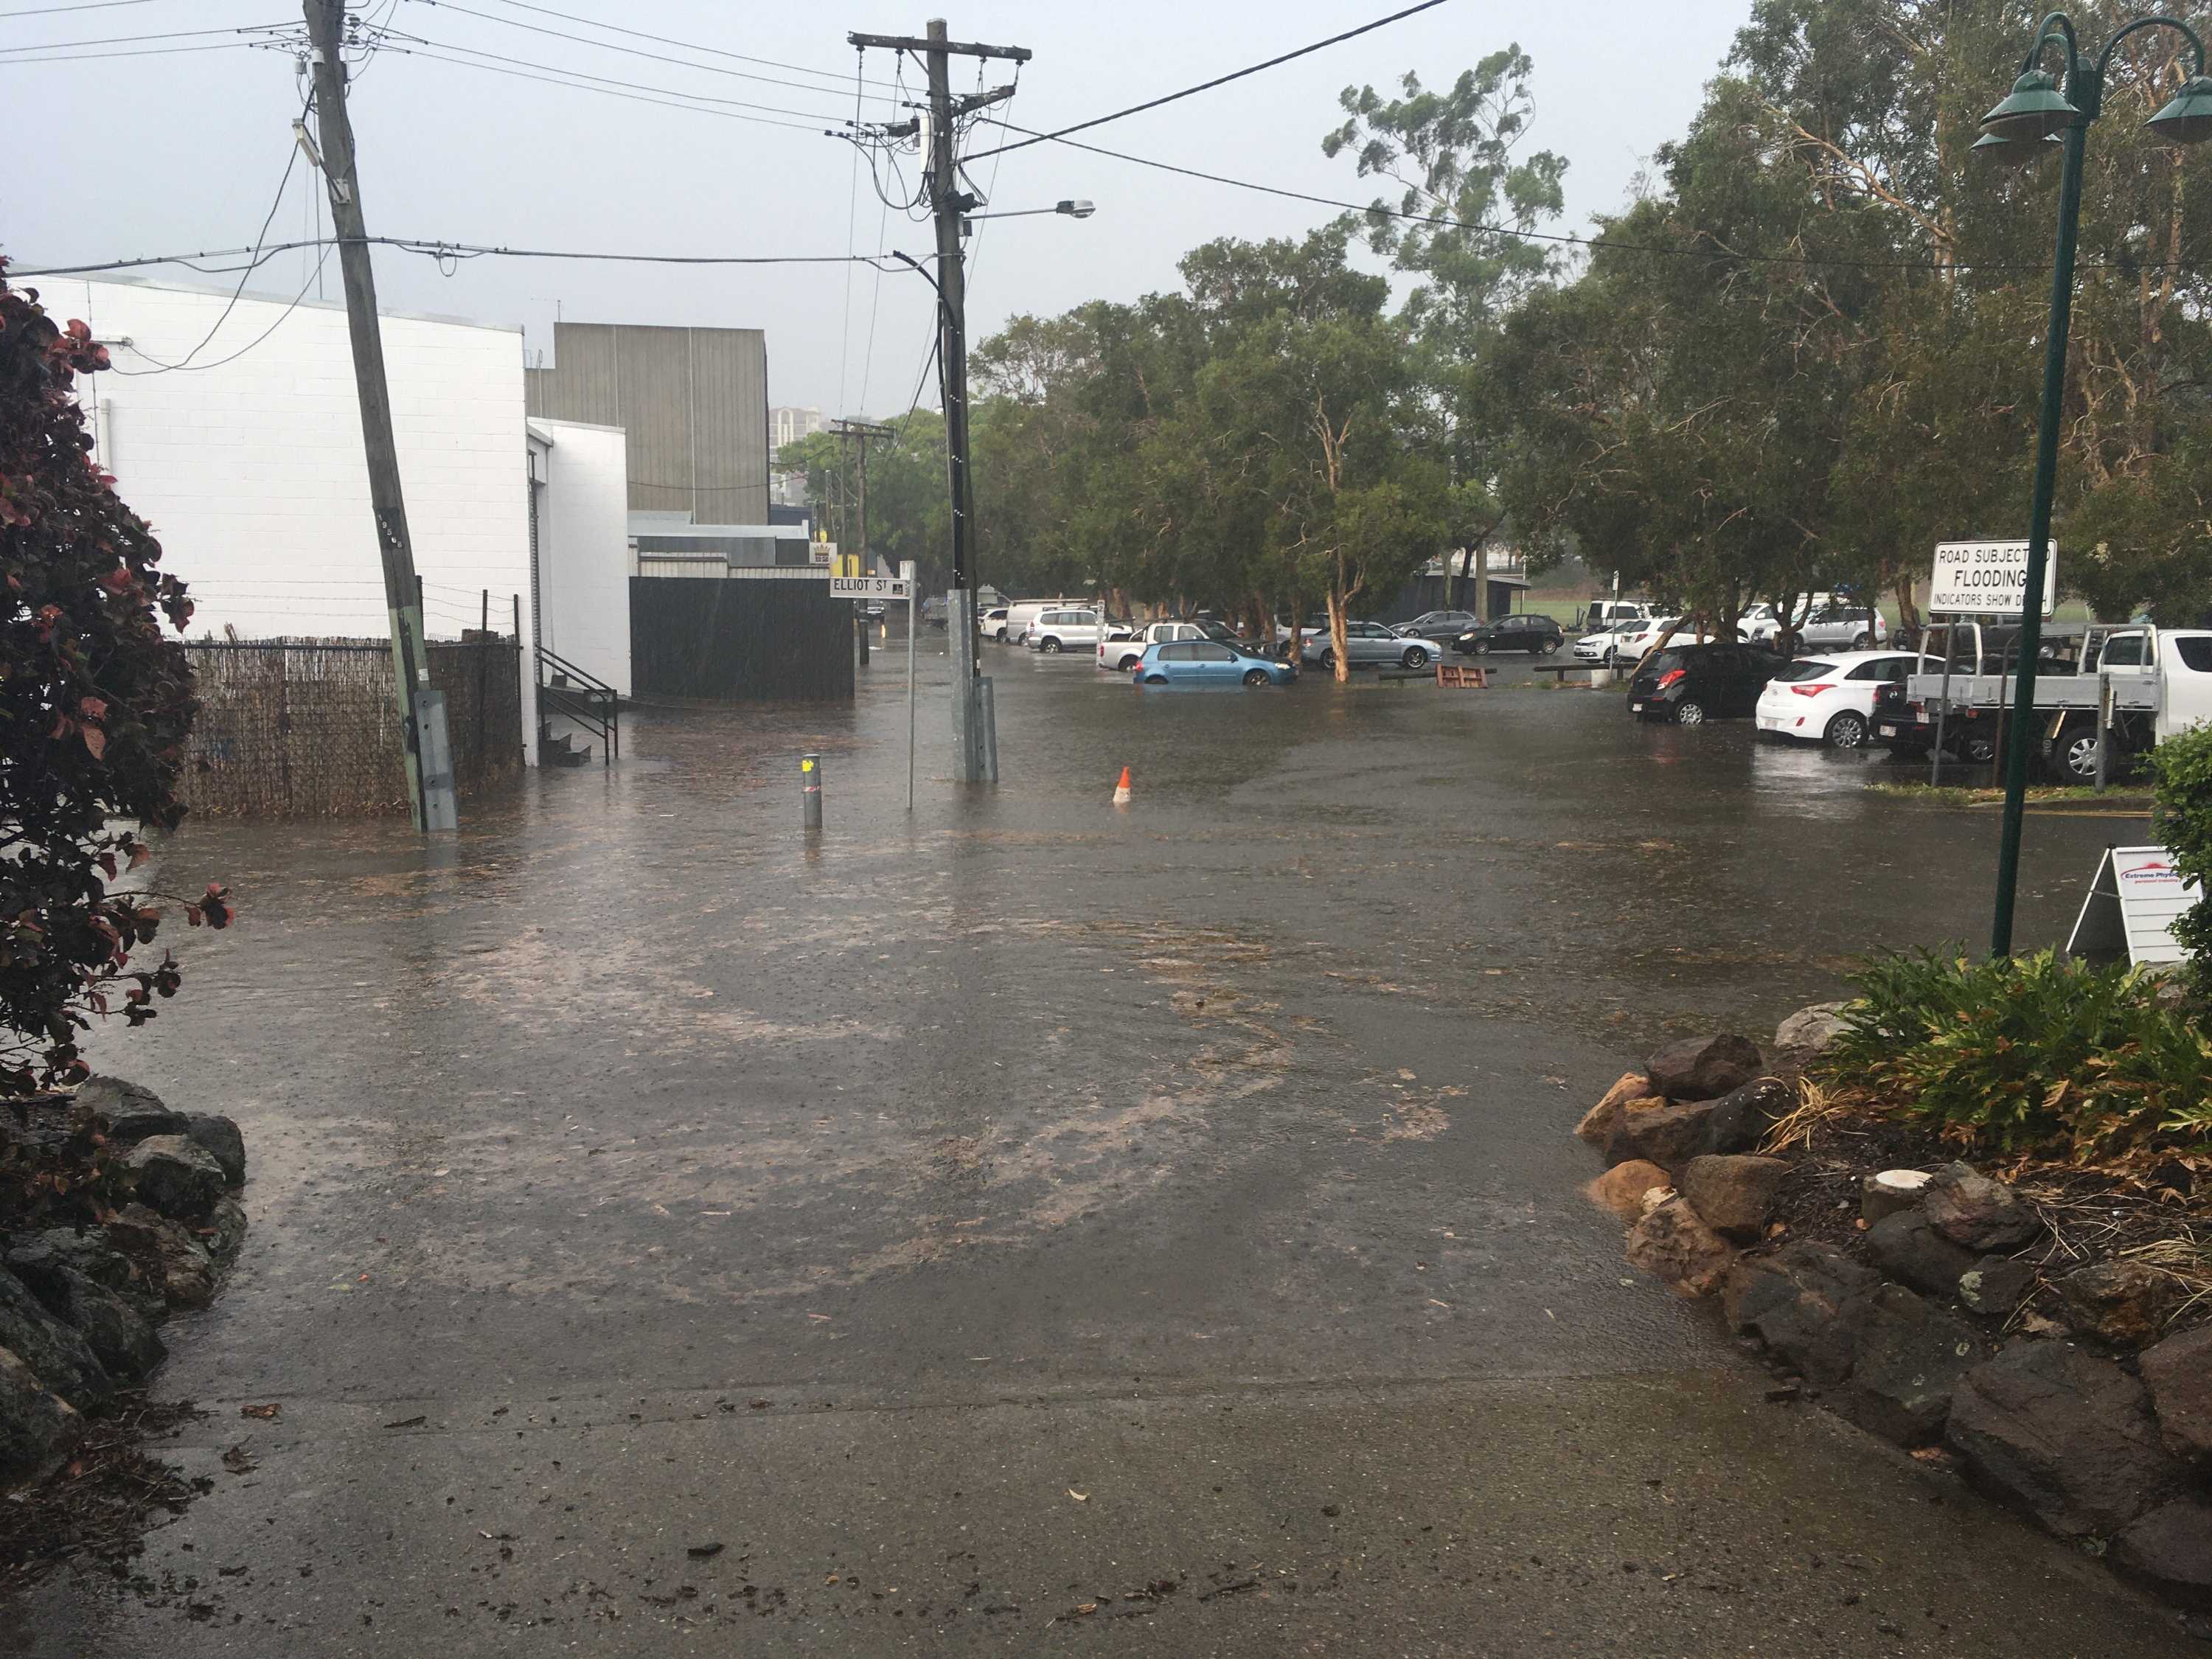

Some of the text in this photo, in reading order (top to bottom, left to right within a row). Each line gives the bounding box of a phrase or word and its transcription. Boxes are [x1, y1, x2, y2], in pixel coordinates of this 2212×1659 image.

[1939, 550, 1969, 563] ROAD
[1975, 549, 2029, 563] SUBJECT
[1954, 570, 2027, 587] FLOODING
[834, 580, 870, 591] ELLIOT
[875, 580, 887, 591] ST
[1934, 593, 1981, 605] INDICATORS
[1986, 594, 2012, 606] SHOW
